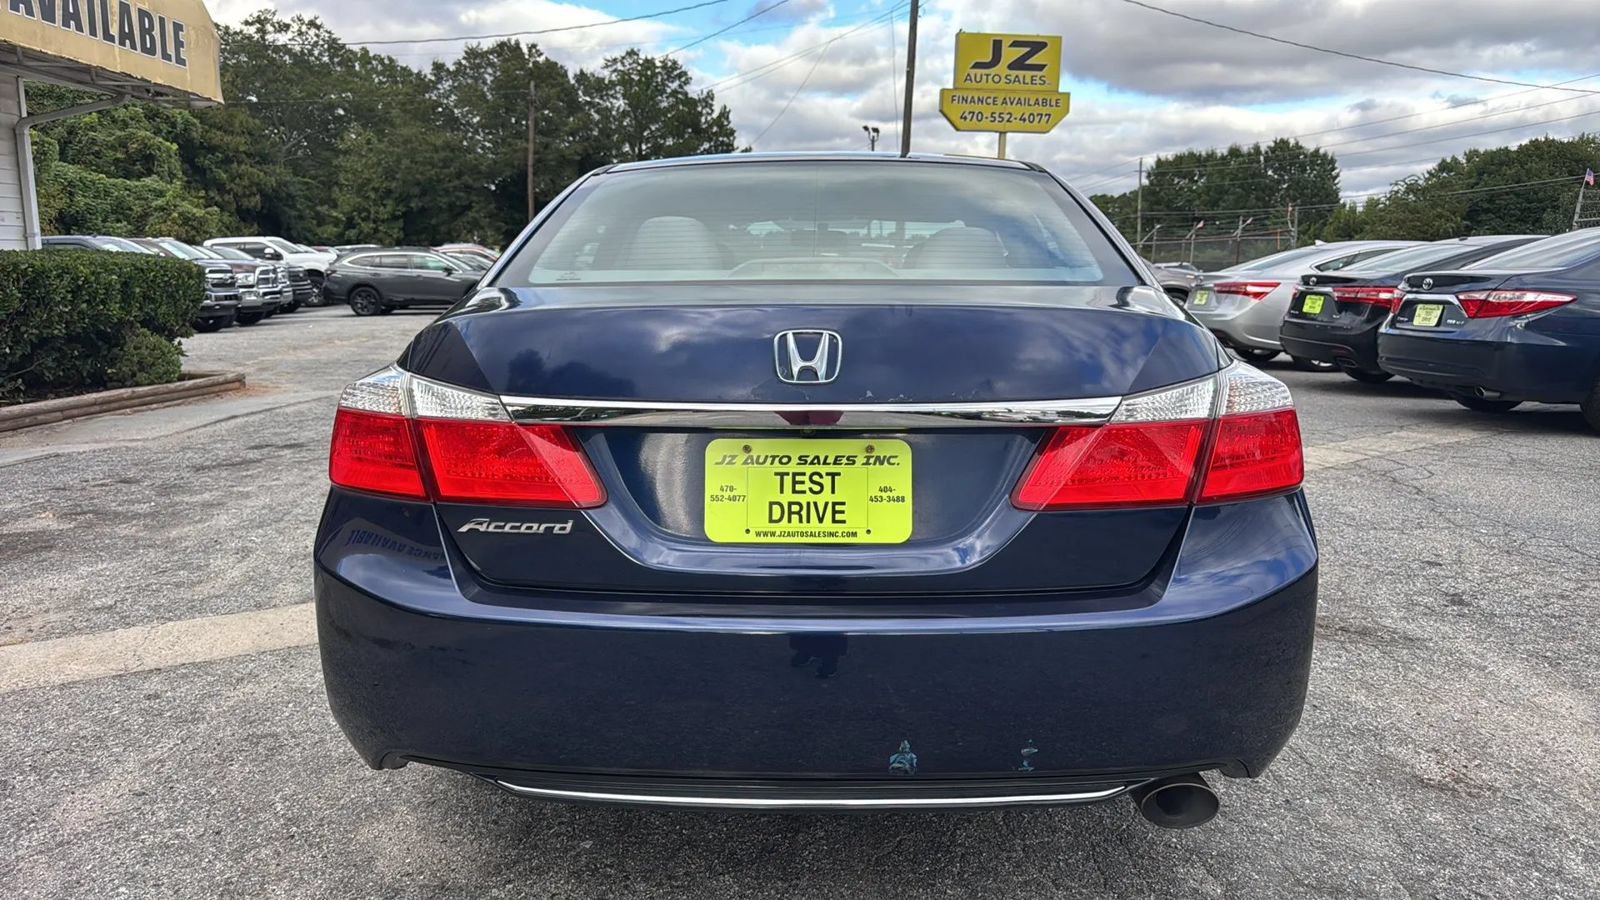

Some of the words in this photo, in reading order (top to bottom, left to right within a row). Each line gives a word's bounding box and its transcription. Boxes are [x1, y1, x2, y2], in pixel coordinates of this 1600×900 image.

[969, 39, 1048, 72] JZ
[964, 73, 1002, 84] AUTO
[1004, 74, 1047, 85] SALES
[951, 95, 998, 106] FINANCE
[1000, 96, 1062, 107] AVAILABLE
[960, 111, 1052, 124] 470-552-4077
[714, 454, 739, 466] JZ
[742, 454, 792, 466] AUTO
[796, 454, 857, 466] SALES
[861, 455, 901, 466] INC.
[774, 471, 842, 495] TEST
[767, 501, 847, 524] DRIVE
[457, 517, 574, 535] Accord
[755, 529, 858, 538] WWW.JZAUTOSALESINC.COM
